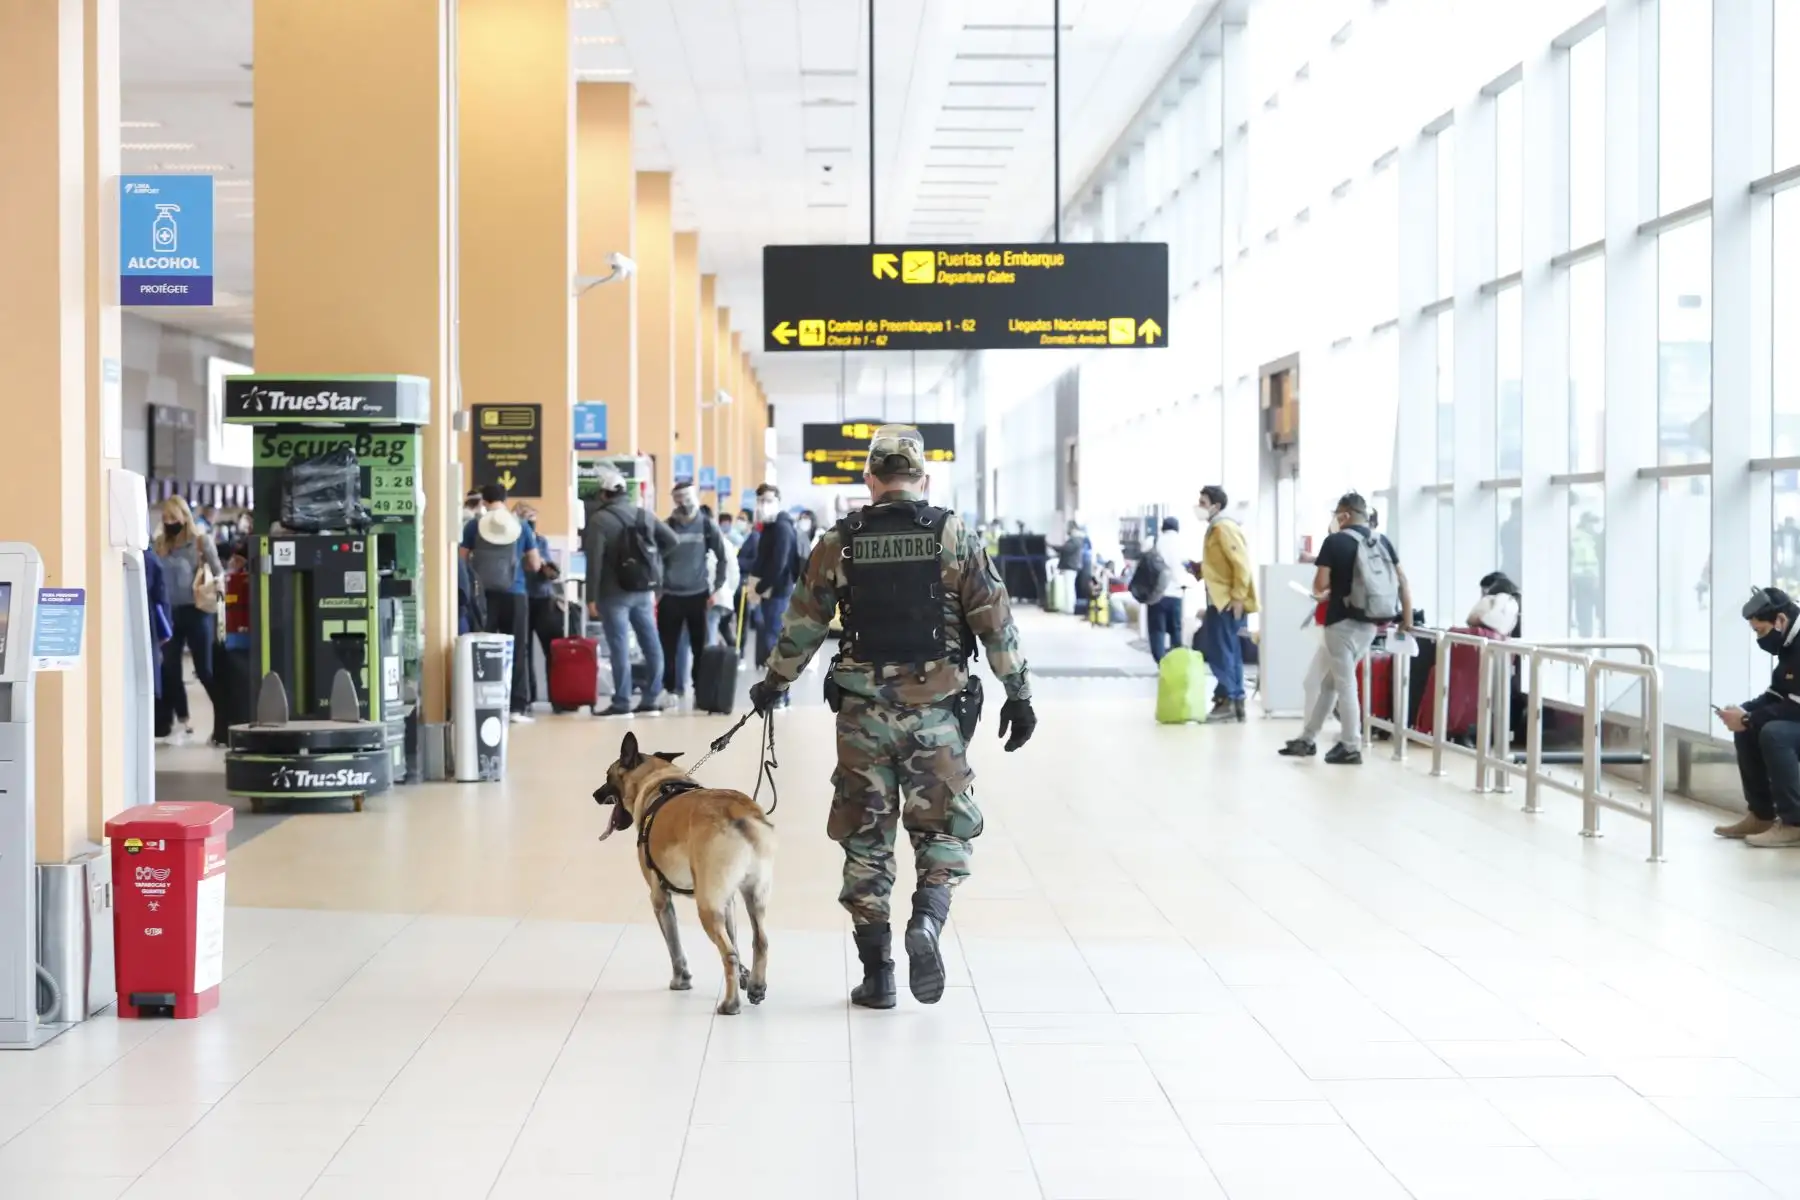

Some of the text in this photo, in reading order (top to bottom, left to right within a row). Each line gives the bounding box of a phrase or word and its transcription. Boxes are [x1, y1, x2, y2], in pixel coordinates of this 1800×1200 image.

[127, 257, 201, 270] ALCOHOL
[937, 251, 1065, 269] Puertas de Embarque
[936, 270, 1016, 286] Departure Gates
[140, 283, 189, 294] PROTÉGETE
[827, 319, 863, 333] Control
[865, 319, 878, 332] de
[945, 319, 952, 331] 1
[961, 318, 977, 332] 62
[1008, 318, 1108, 334] Llegadas Nacionales
[875, 334, 889, 346] 62
[268, 390, 364, 412] TrueStar
[279, 548, 292, 557] 15
[854, 536, 935, 560] DIRANDRO
[294, 768, 373, 788] TrueStar
